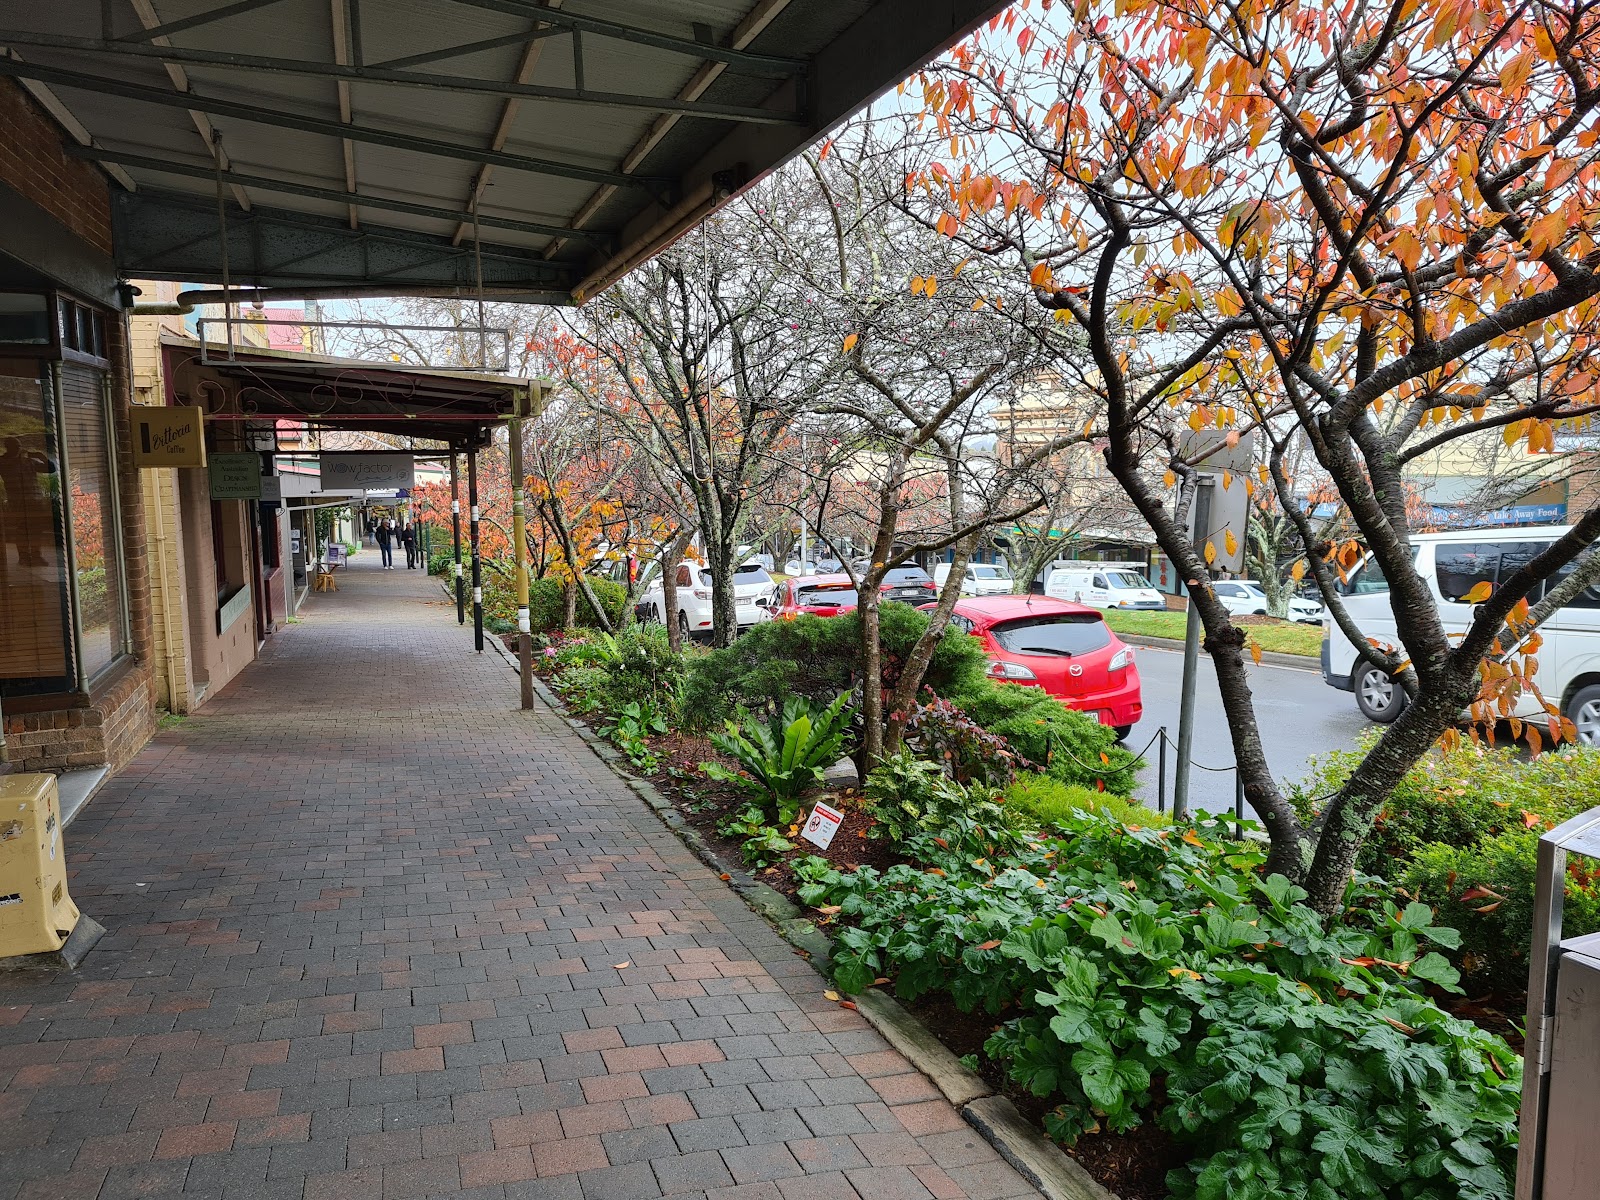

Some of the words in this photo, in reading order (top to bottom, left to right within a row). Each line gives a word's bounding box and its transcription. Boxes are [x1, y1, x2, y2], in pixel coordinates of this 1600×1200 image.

[153, 424, 191, 450] Vittoria
[1514, 510, 1535, 519] Away
[1538, 508, 1558, 516] Food
